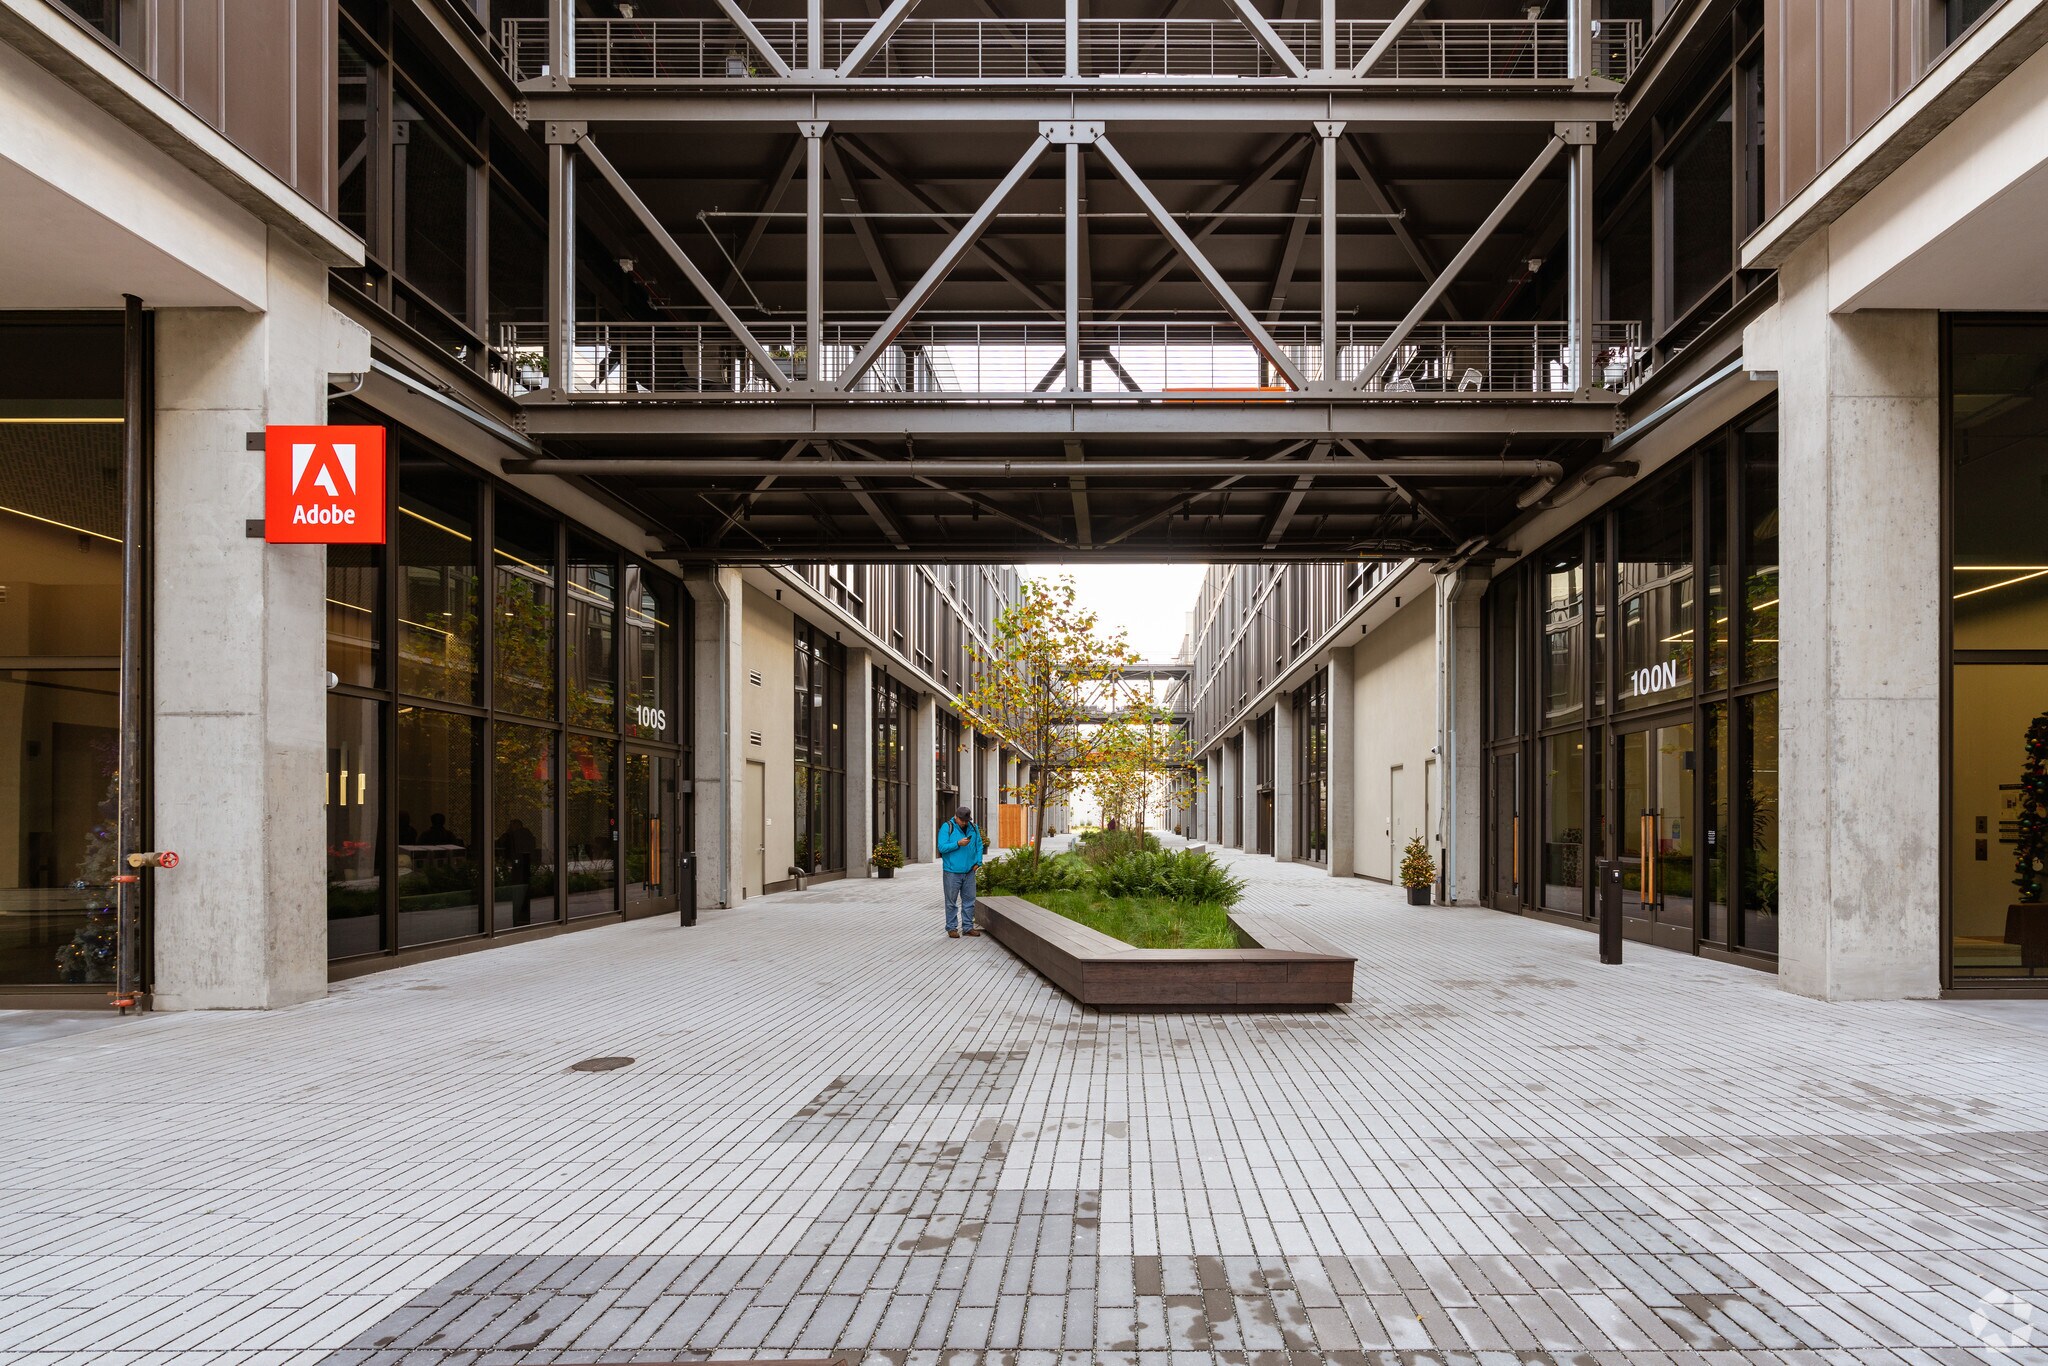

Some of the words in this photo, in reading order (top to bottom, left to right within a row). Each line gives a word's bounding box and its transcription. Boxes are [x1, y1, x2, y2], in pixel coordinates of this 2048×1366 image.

[292, 503, 356, 525] Adobe
[1630, 659, 1677, 697] 100N
[635, 704, 666, 731] 100S
